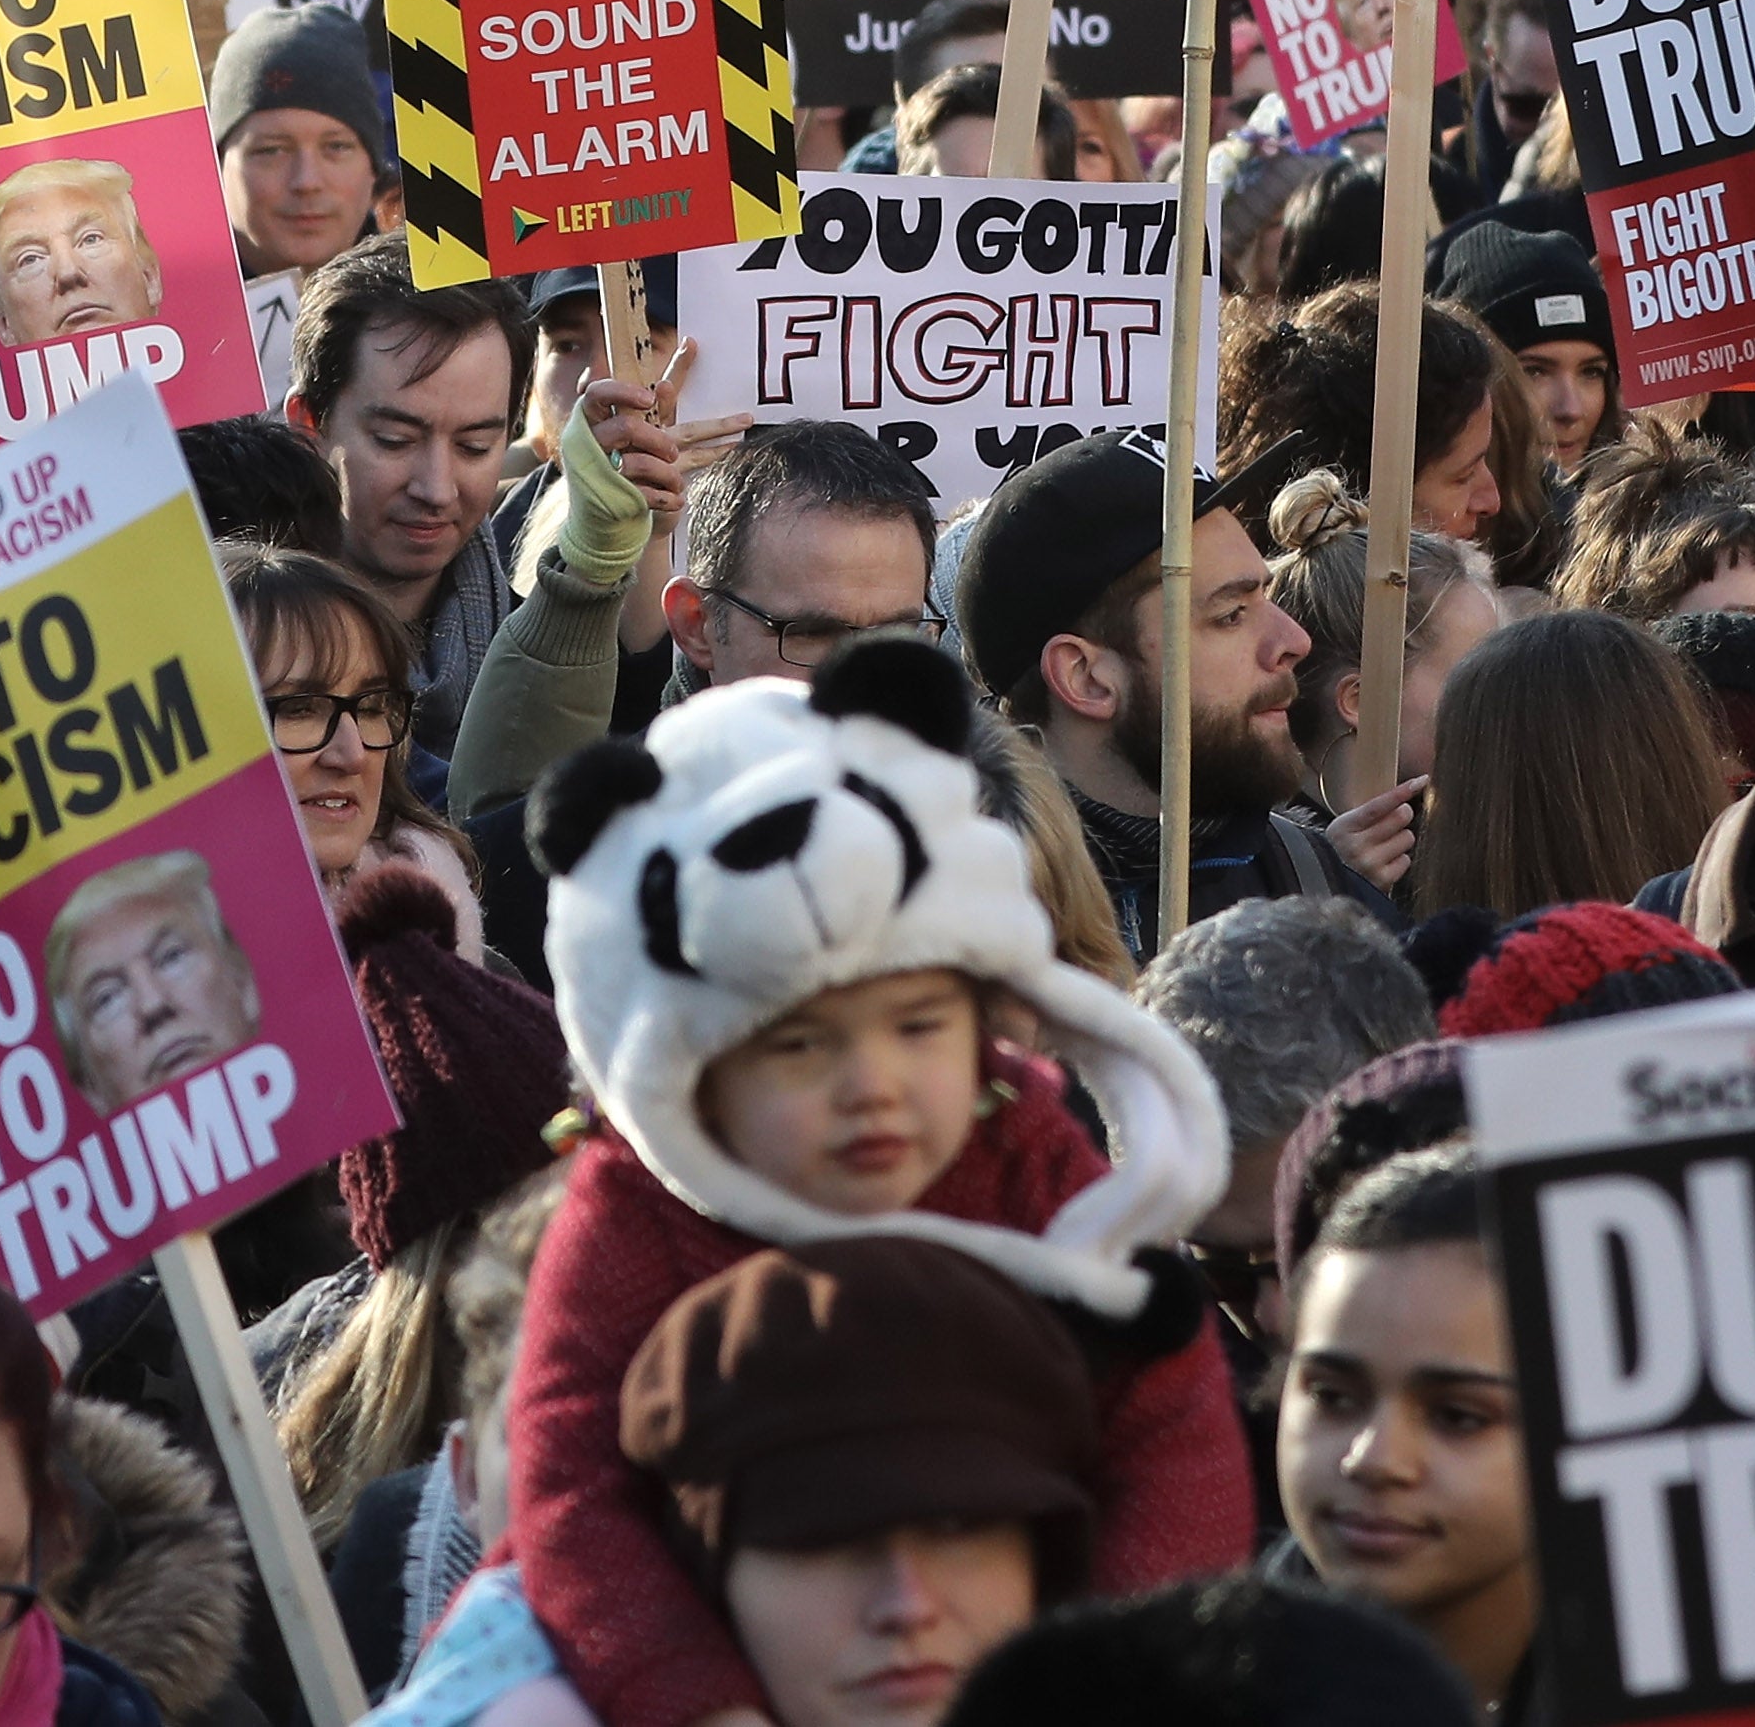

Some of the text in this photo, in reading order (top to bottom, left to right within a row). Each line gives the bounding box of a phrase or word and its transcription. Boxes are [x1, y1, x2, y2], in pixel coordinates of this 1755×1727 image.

[1048, 5, 1112, 47] No
[1279, 19, 1342, 82] TO
[531, 57, 655, 114] THE
[1294, 46, 1392, 131] TRU
[489, 110, 710, 183] ALARM
[1610, 181, 1729, 268] FIGHT
[756, 293, 1162, 409] FIGHT
[15, 454, 61, 510] UP
